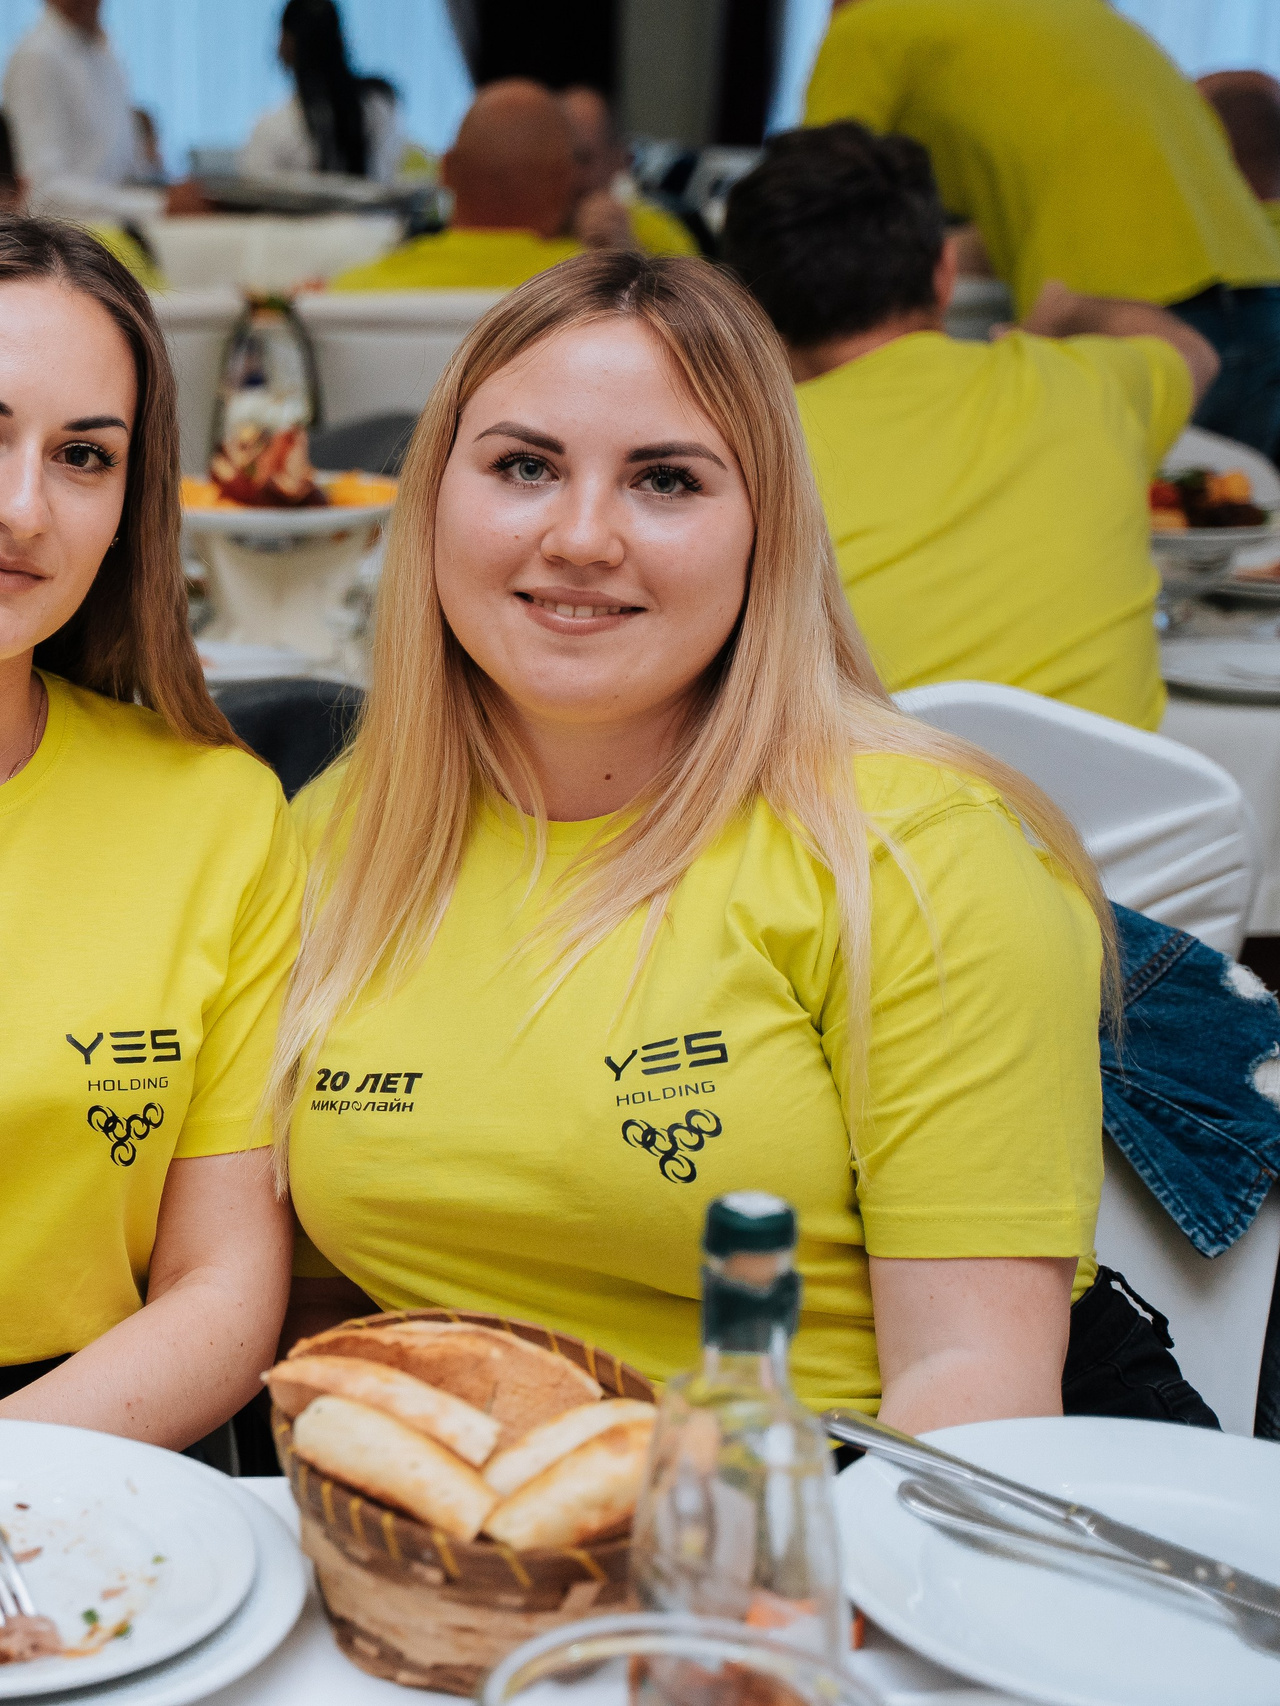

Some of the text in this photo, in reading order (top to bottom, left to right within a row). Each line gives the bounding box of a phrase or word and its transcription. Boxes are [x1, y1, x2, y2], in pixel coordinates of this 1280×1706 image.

[65, 1029, 181, 1065] YES
[604, 1030, 728, 1082] YES
[88, 1076, 169, 1092] HOLDING
[315, 1068, 423, 1094] 20 ЛЕТ
[616, 1080, 716, 1107] HOLDING
